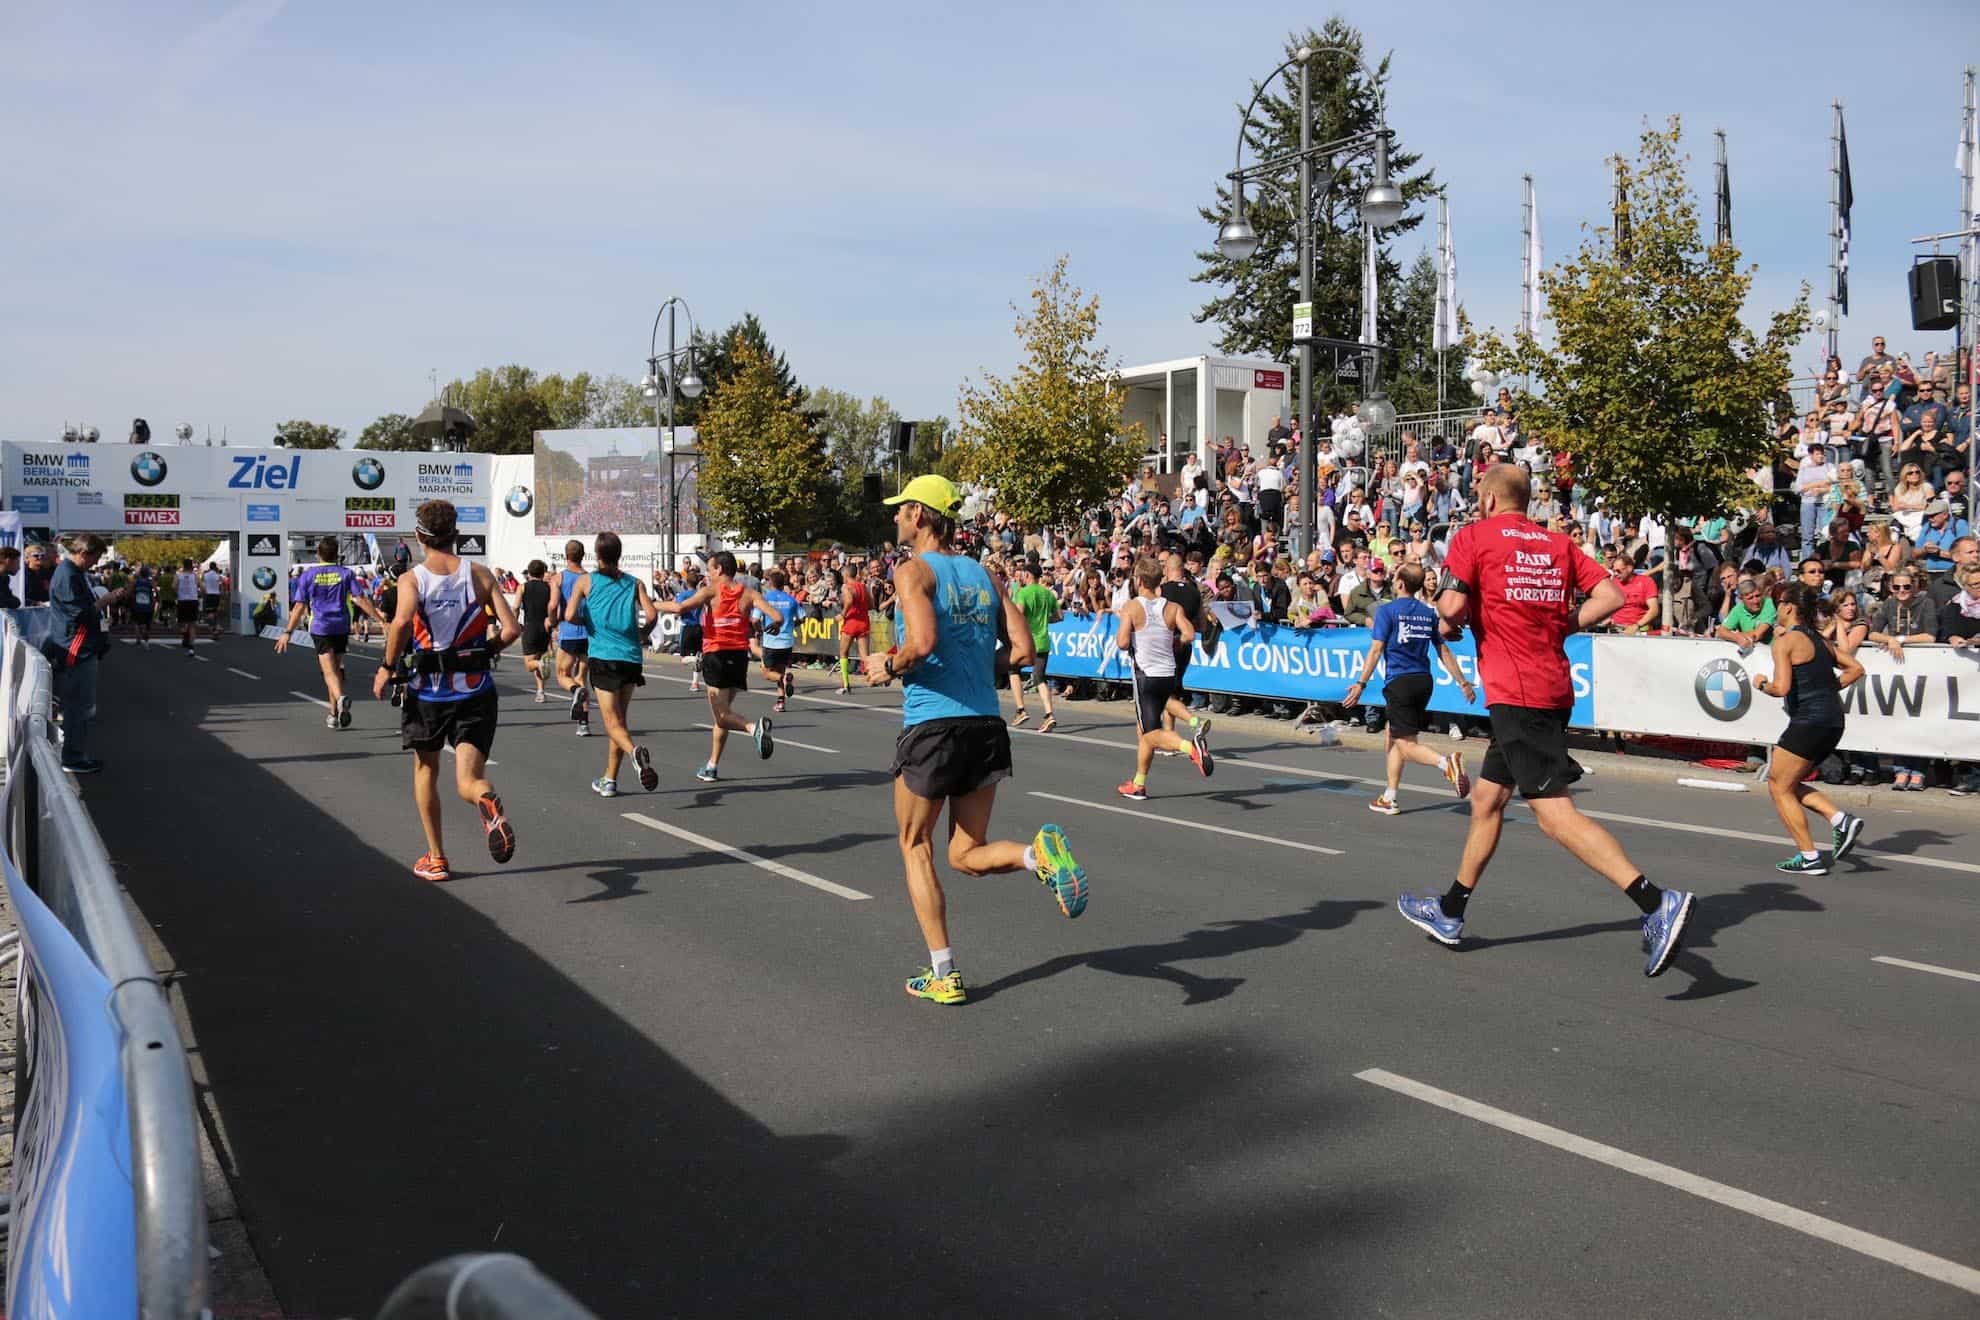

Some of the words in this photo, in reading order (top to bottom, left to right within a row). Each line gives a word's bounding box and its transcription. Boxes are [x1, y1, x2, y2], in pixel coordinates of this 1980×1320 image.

[23, 454, 64, 466] BMW
[23, 467, 65, 476] BERLIN
[228, 455, 301, 489] Ziel
[418, 464, 452, 475] BMW
[23, 477, 90, 487] MARATHON
[418, 475, 453, 484] BERLIN
[418, 485, 473, 494] MARATHON
[127, 511, 177, 523] TIMEX
[347, 515, 393, 526] TIMEX
[1515, 550, 1552, 566] PAIN
[1504, 588, 1565, 602] FOREVER!
[801, 617, 834, 645] your
[1838, 674, 1927, 718] MW
